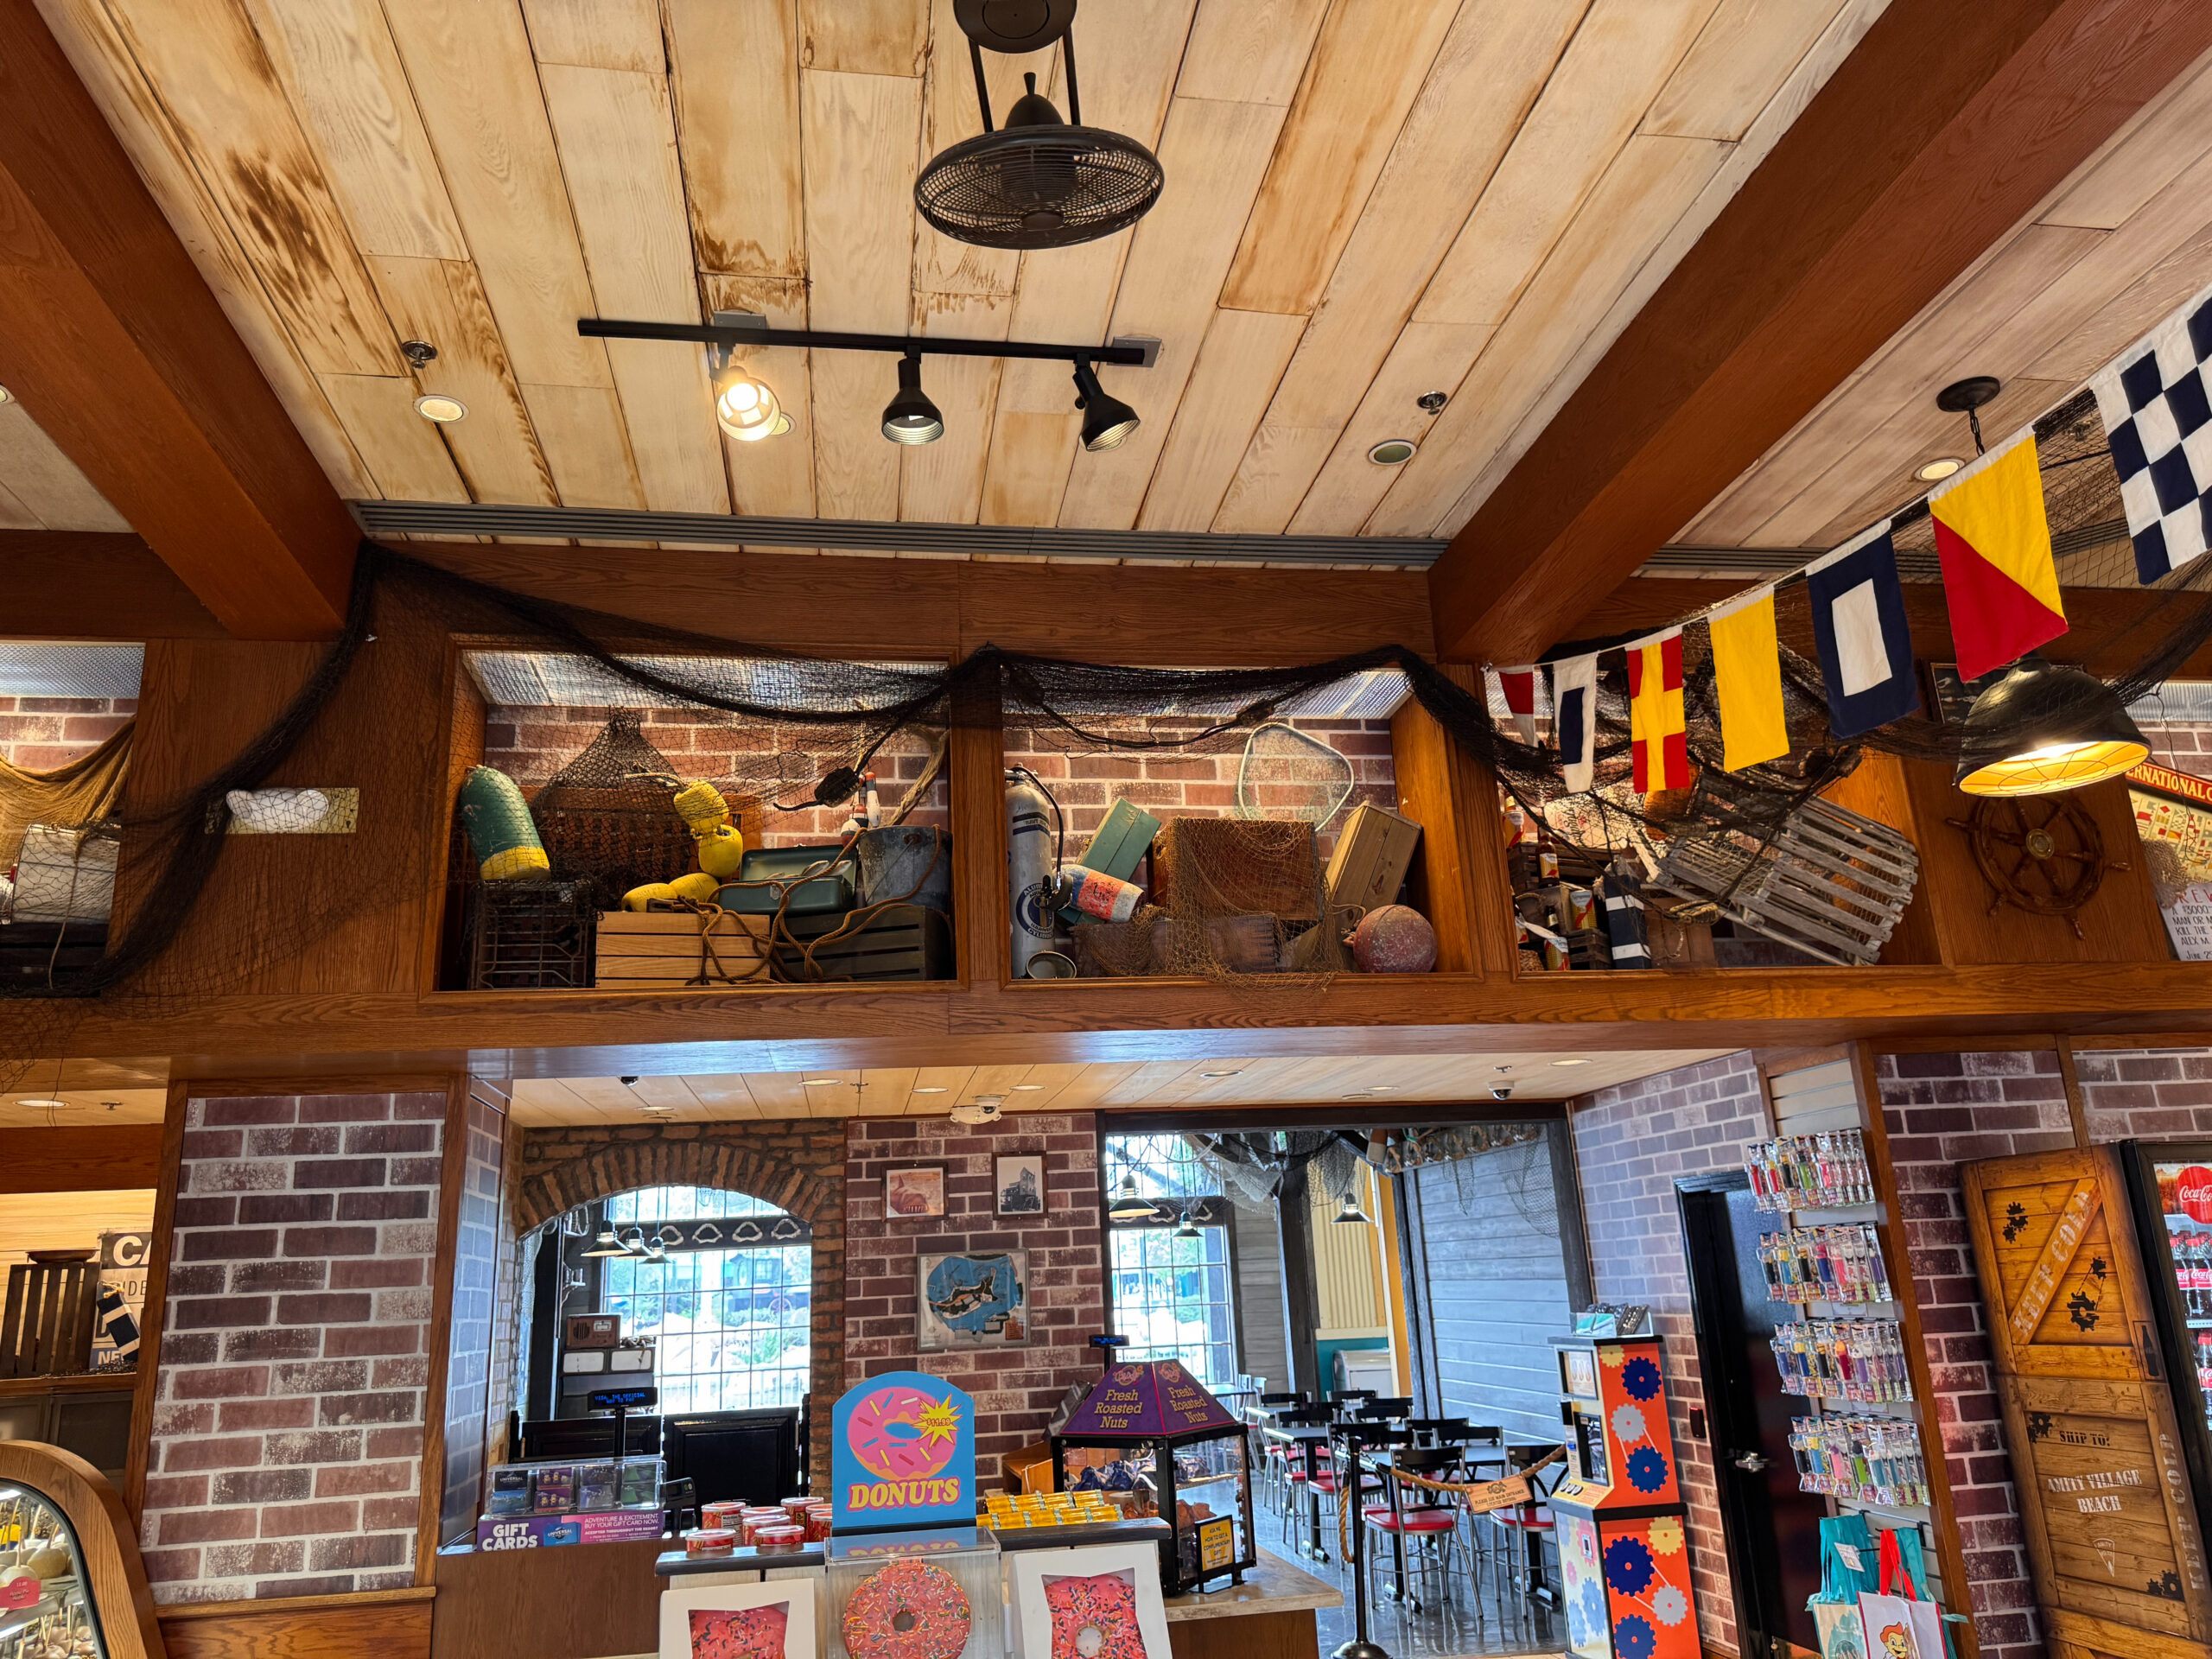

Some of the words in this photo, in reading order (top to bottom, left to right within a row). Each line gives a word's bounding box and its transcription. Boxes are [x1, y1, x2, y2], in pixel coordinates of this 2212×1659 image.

[2172, 917, 2191, 925] MAN
[2193, 916, 2204, 925] OR
[2176, 927, 2190, 936] KILL
[2195, 926, 2208, 935] THE
[2181, 937, 2199, 945] ALEX
[2013, 1263, 2054, 1337] KEEP
[2051, 1192, 2092, 1262] COLD
[1104, 1389, 1139, 1402] Fresh
[1168, 1384, 1197, 1399] Fresh
[1094, 1402, 1143, 1414] Roasted
[1169, 1396, 1209, 1412] Roasted
[926, 1418, 950, 1427] $11.99
[1099, 1416, 1128, 1429] Nuts
[1185, 1411, 1209, 1424] Nuts
[2059, 1431, 2087, 1444] SHIP
[2159, 1433, 2185, 1503] COLD
[2048, 1476, 2085, 1493] AMITY
[2087, 1469, 2142, 1490] VILLAGE
[849, 1478, 959, 1509] DONUTS
[2076, 1496, 2122, 1513] BEACH
[493, 1523, 529, 1537] GIFT
[482, 1535, 538, 1551] CARDS
[2177, 1516, 2204, 1589] KEEP
